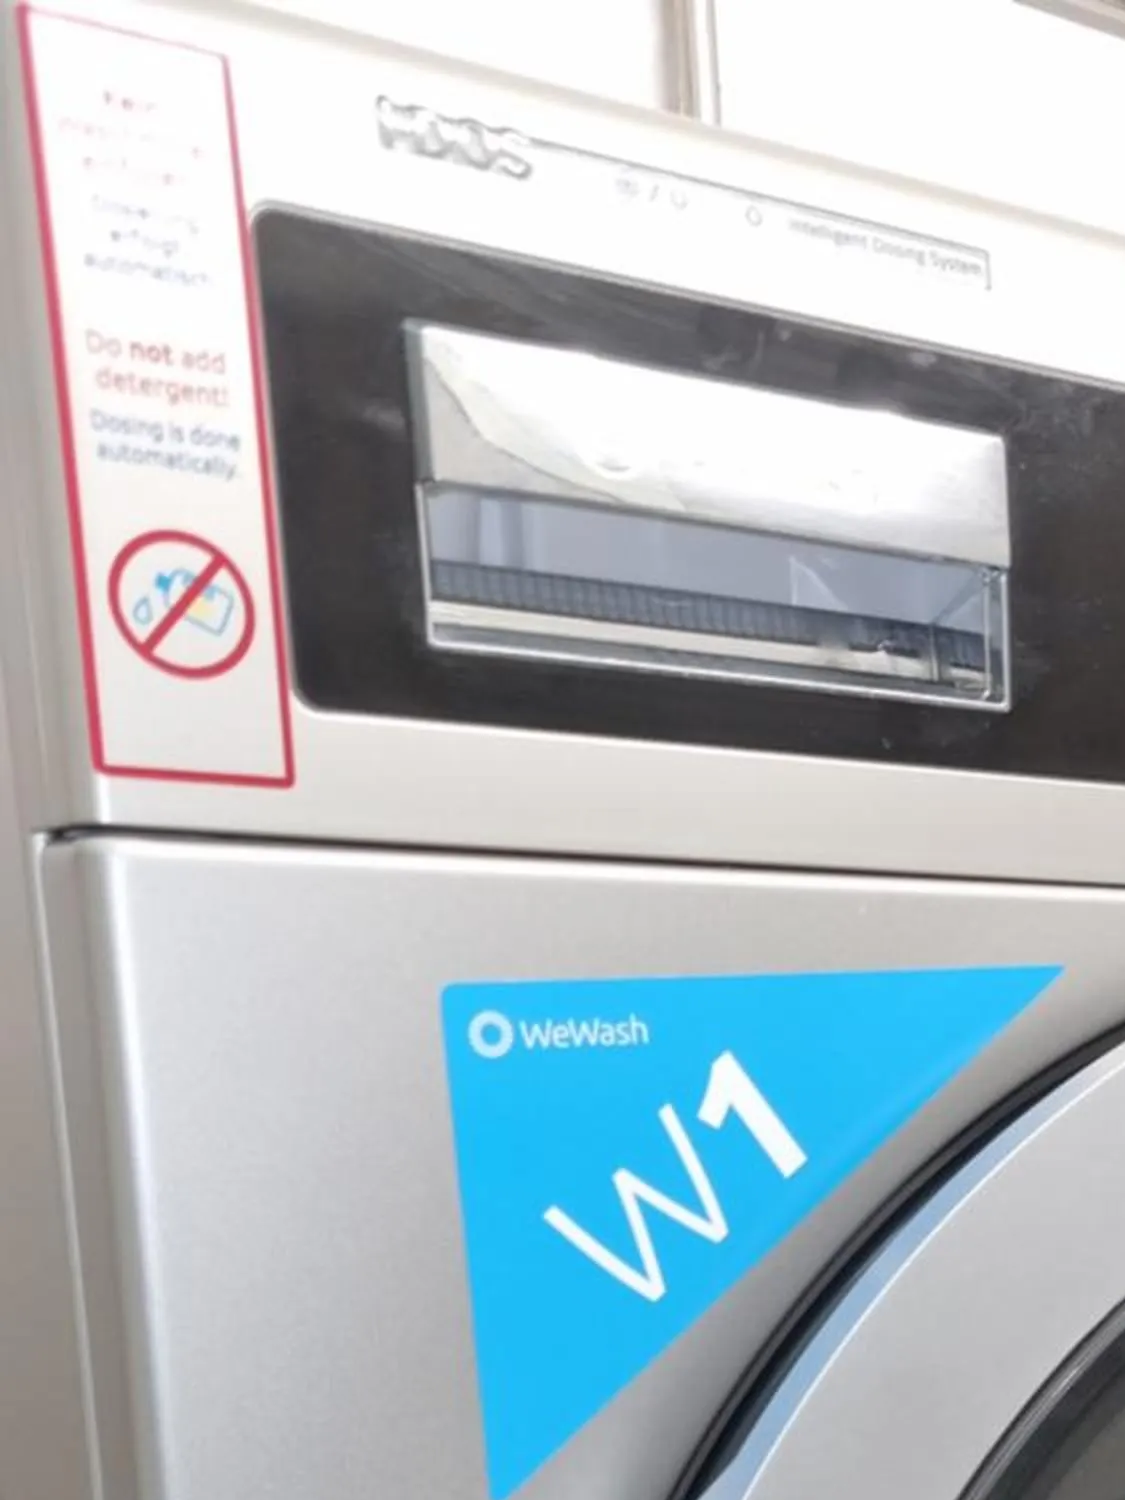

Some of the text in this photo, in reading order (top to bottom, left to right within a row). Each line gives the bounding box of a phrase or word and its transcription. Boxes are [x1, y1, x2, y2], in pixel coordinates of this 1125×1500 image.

[85, 328, 226, 375] Do not add
[89, 408, 241, 452] Dosing is done
[519, 1013, 650, 1051] WeWash
[543, 1049, 808, 1302] W1
